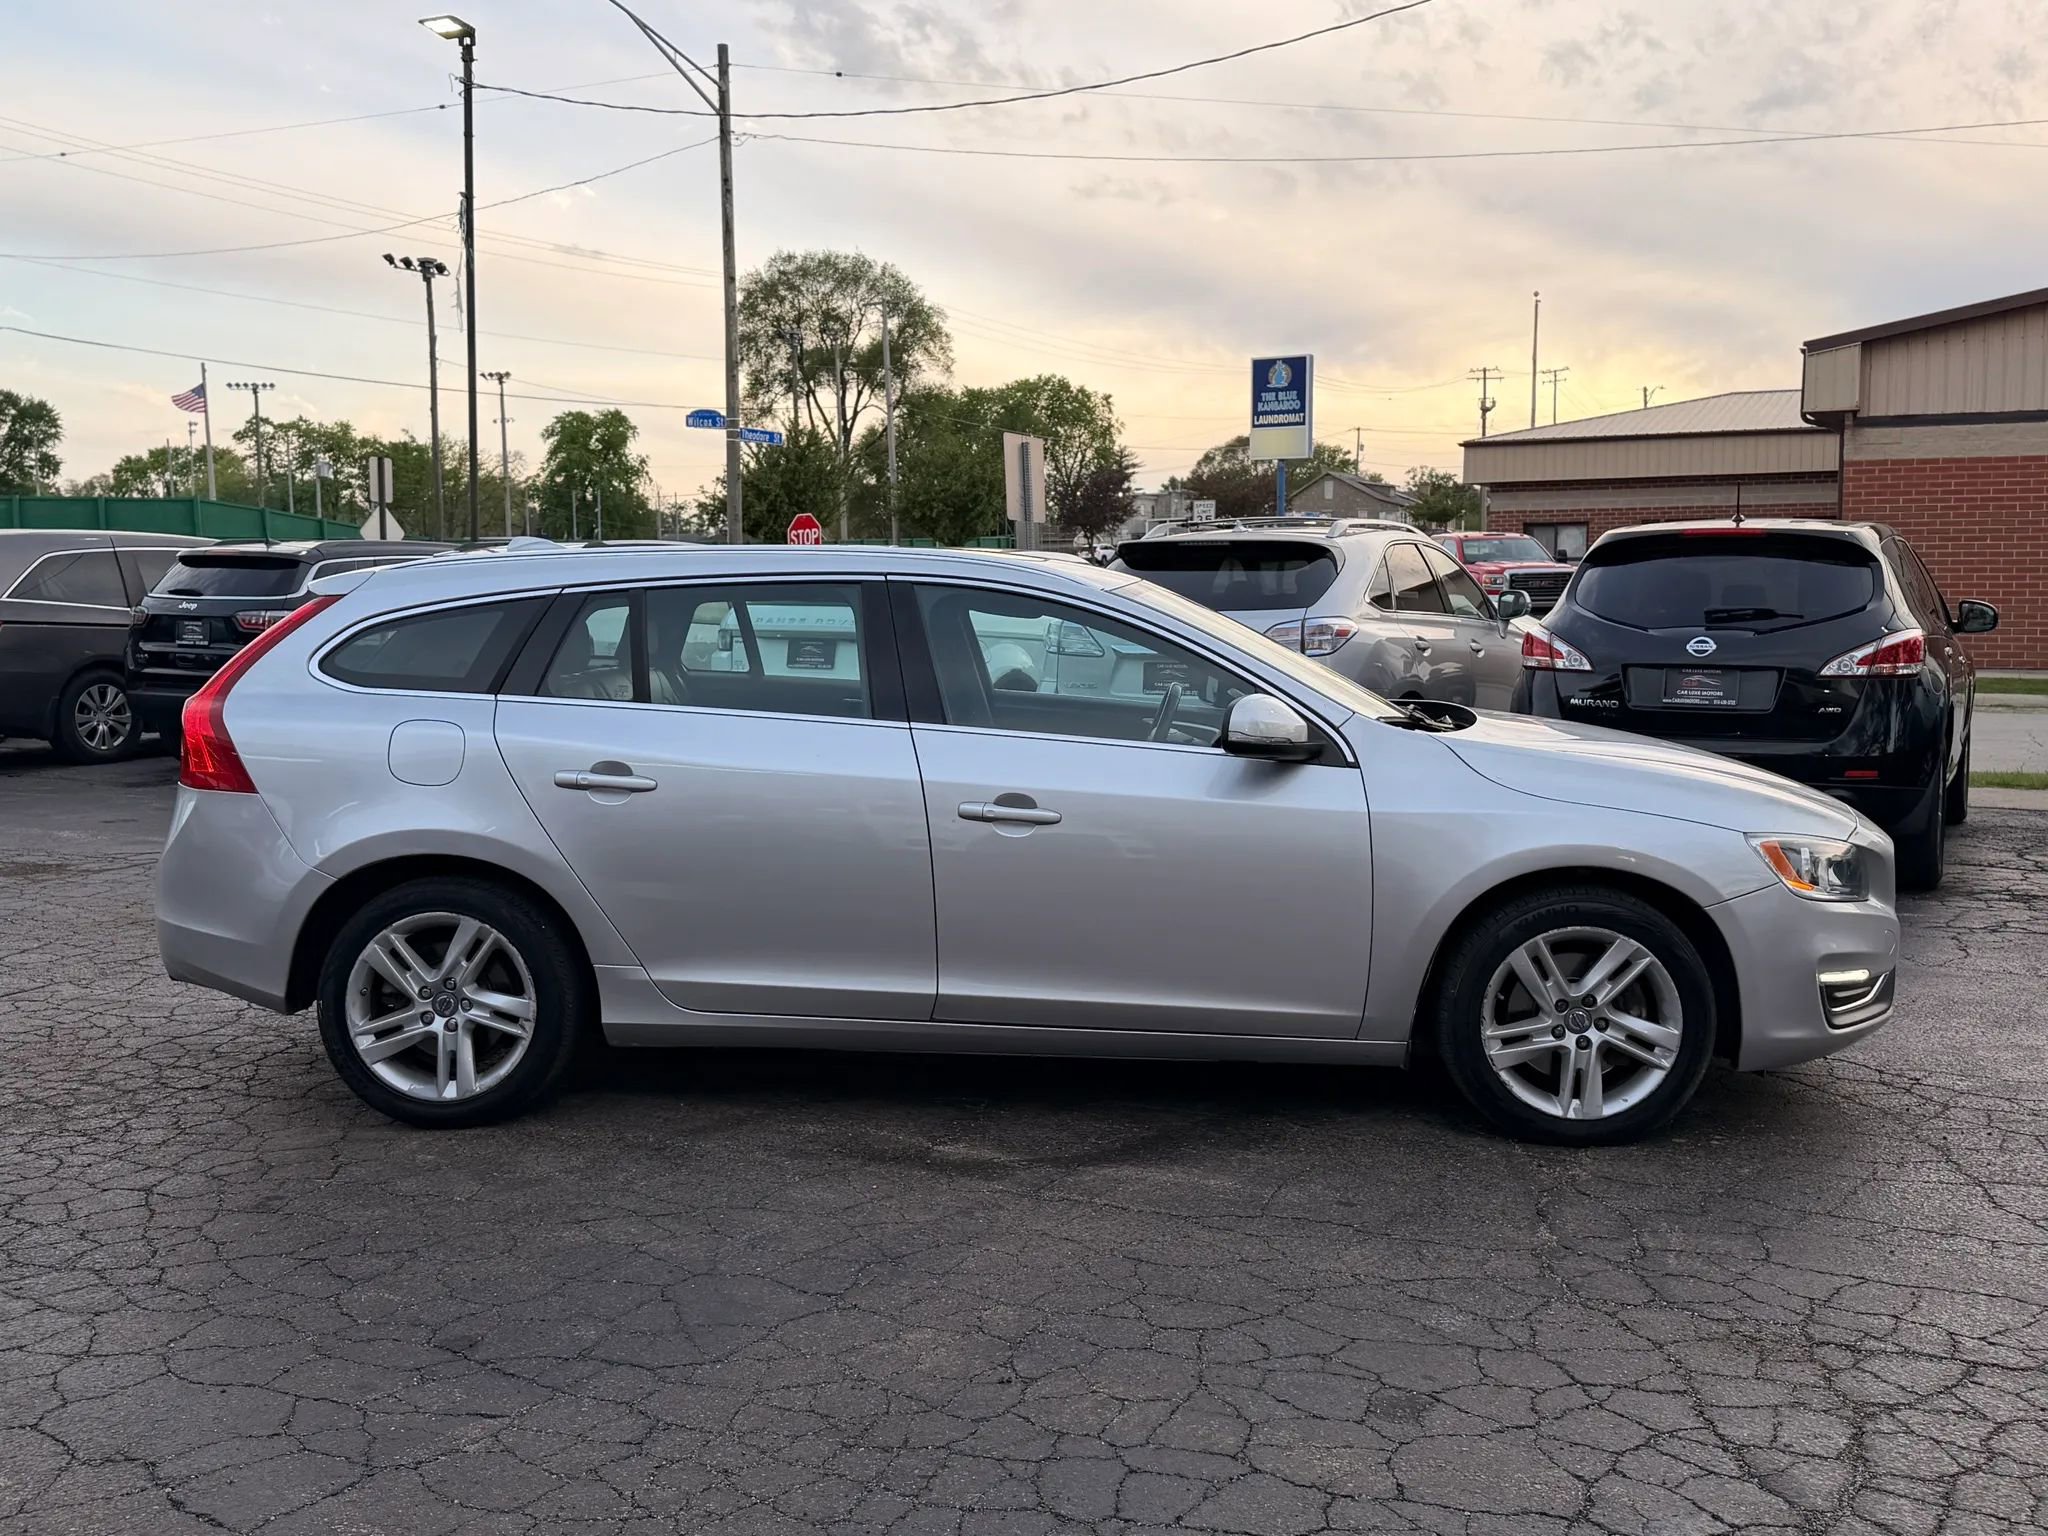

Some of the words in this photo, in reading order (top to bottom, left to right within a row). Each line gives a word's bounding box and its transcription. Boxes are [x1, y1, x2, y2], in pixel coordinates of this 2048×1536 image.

[1261, 392, 1276, 401] THE
[1278, 390, 1297, 400] BLUE
[1257, 400, 1301, 411] KANGAROO
[687, 416, 713, 427] Wilcox
[716, 416, 725, 427] St
[1254, 413, 1304, 425] LAUNDROMAT
[774, 433, 780, 443] St
[790, 528, 819, 545] STOP
[178, 601, 198, 611] Jeep
[1570, 698, 1619, 708] MURANO
